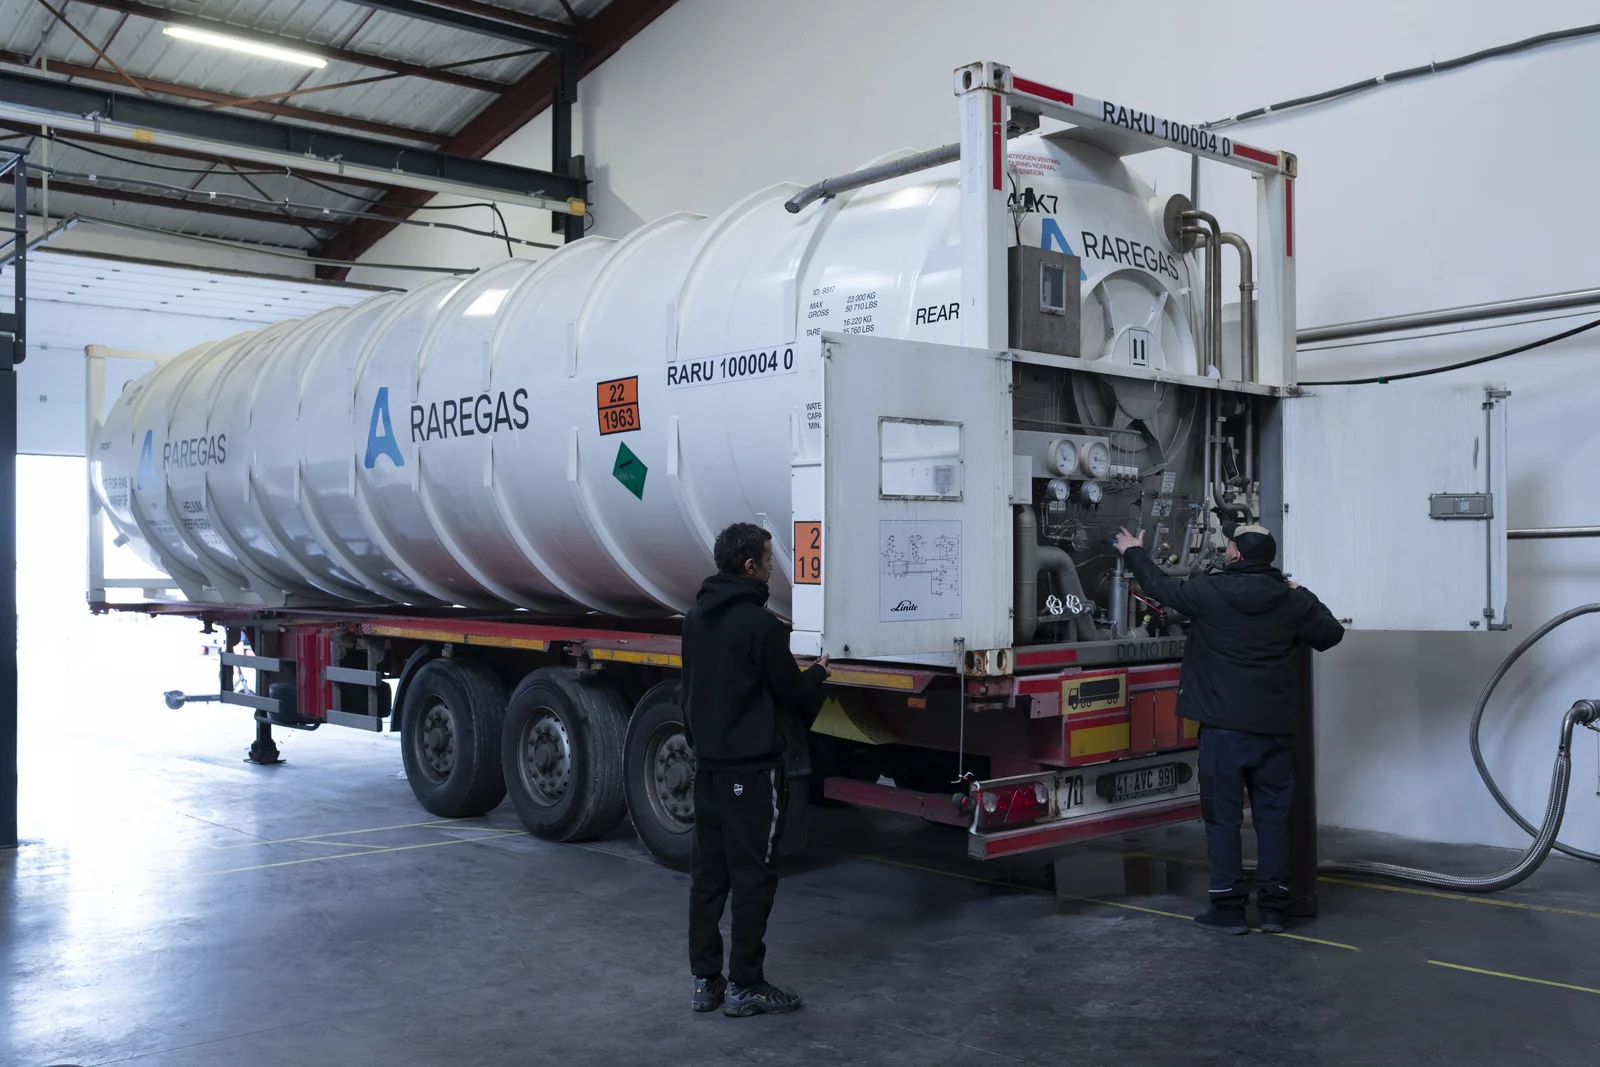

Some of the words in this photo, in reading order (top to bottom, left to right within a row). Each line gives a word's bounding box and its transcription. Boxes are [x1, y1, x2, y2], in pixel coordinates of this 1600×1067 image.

[1102, 100, 1156, 135] RARU
[1162, 119, 1218, 153] 100004
[1222, 138, 1231, 157] 0
[1008, 160, 1032, 168] DURING
[1032, 163, 1057, 171] NORMAL
[1037, 156, 1061, 165] VENTING
[1013, 168, 1045, 176] ERATION
[1081, 231, 1180, 281] RAREGAS
[812, 288, 821, 297] ID:
[855, 293, 866, 302] 000
[866, 291, 876, 300] KG
[807, 308, 830, 319] GROSS
[809, 301, 824, 310] MAX
[845, 304, 853, 313] 50
[853, 302, 865, 311] 710
[865, 300, 878, 310] LBS
[915, 303, 960, 326] REAR
[843, 318, 850, 326] 16
[850, 316, 862, 326] 220
[862, 315, 872, 324] KG
[861, 324, 875, 333] LBS
[806, 327, 821, 337] TARE
[667, 359, 714, 387] RARU
[721, 350, 778, 379] 100004
[784, 348, 794, 371] 0
[608, 382, 625, 404] 22
[410, 388, 530, 443] RAREGAS
[603, 407, 635, 431] 1963
[163, 433, 227, 470] RAREGAS
[810, 527, 821, 550] 2
[798, 556, 821, 579] 19
[890, 599, 918, 612] Linde
[1117, 643, 1136, 660] DO
[1140, 641, 1166, 658] NOT
[1116, 775, 1128, 794] 41
[1134, 770, 1153, 791] AVC
[1158, 768, 1174, 786] 991
[1065, 775, 1084, 809] 70
